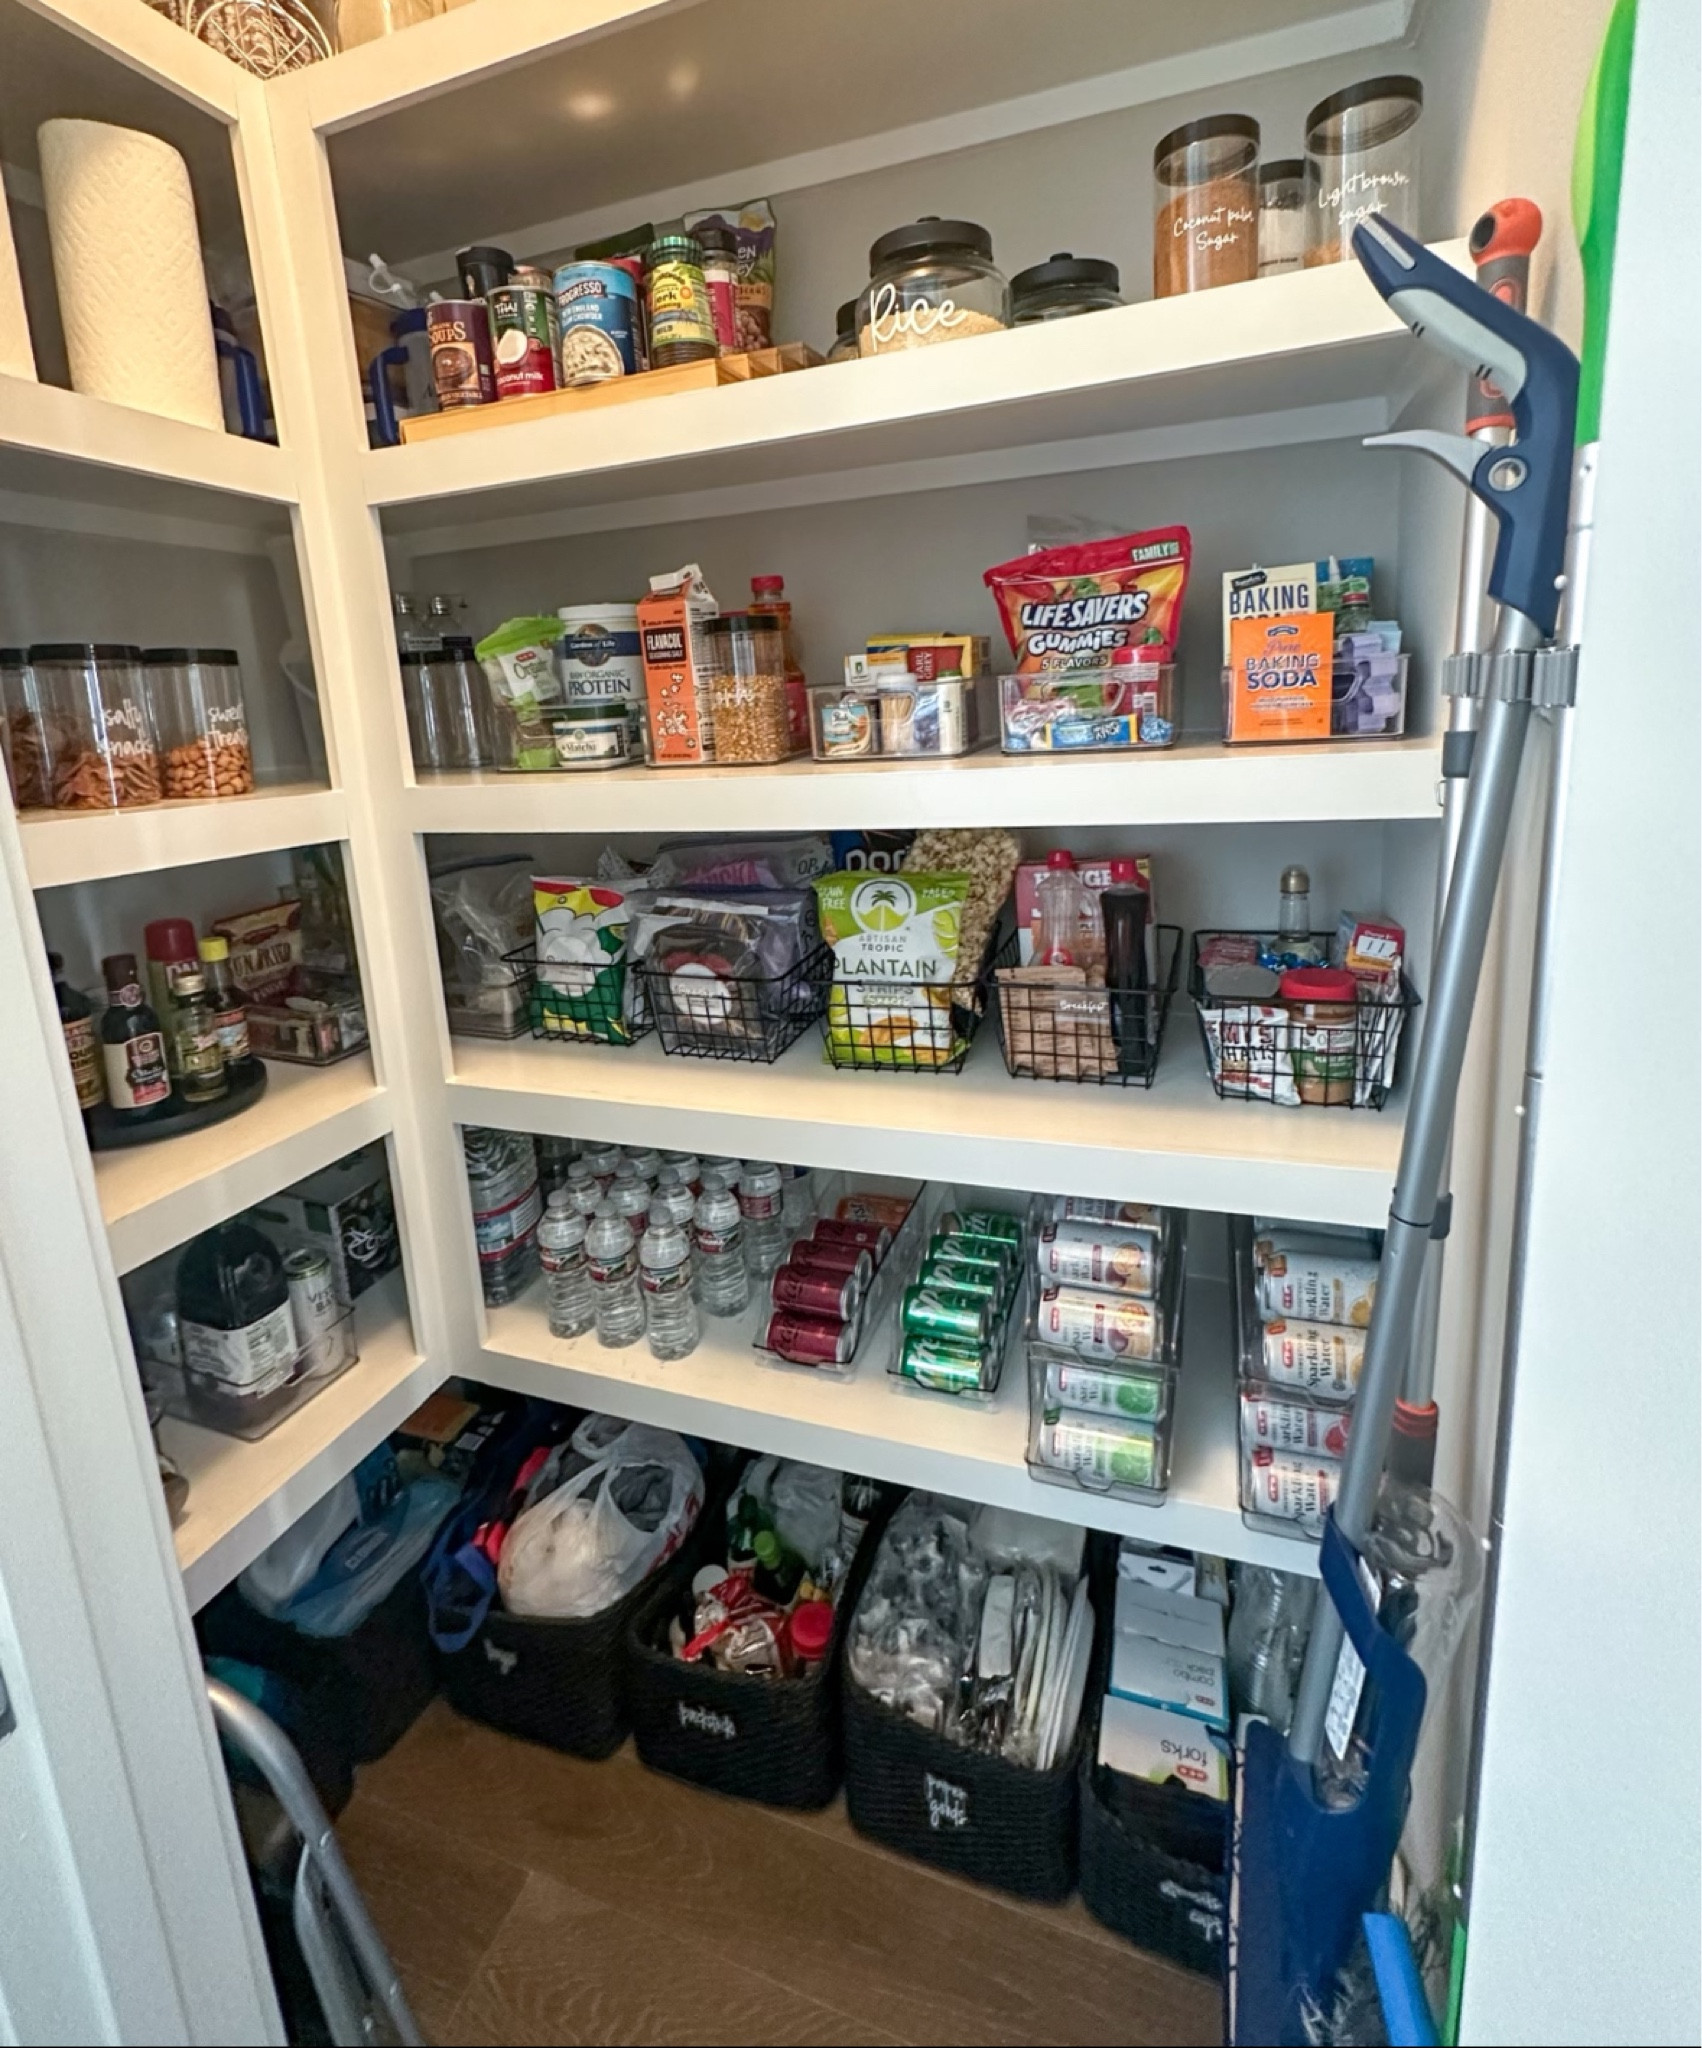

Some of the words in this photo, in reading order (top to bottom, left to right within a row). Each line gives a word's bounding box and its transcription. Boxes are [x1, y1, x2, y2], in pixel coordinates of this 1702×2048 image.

[1196, 231, 1239, 250] Sugar
[870, 282, 968, 353] Rice
[1230, 583, 1309, 615] BAKING
[1028, 629, 1127, 655] GUMMIES
[1052, 656, 1108, 670] FLAVORS
[1246, 653, 1320, 670] BAKING
[586, 669, 625, 679] ORGANIC
[1247, 669, 1317, 690] SODA
[568, 678, 631, 696] PROTEIN
[822, 898, 845, 910] FREE
[859, 934, 907, 943] ARTISAN
[861, 944, 904, 953] TROPIC
[1305, 1329, 1321, 1388] Sparkling
[1319, 1338, 1333, 1377] Water
[1160, 1739, 1208, 1767] forks
